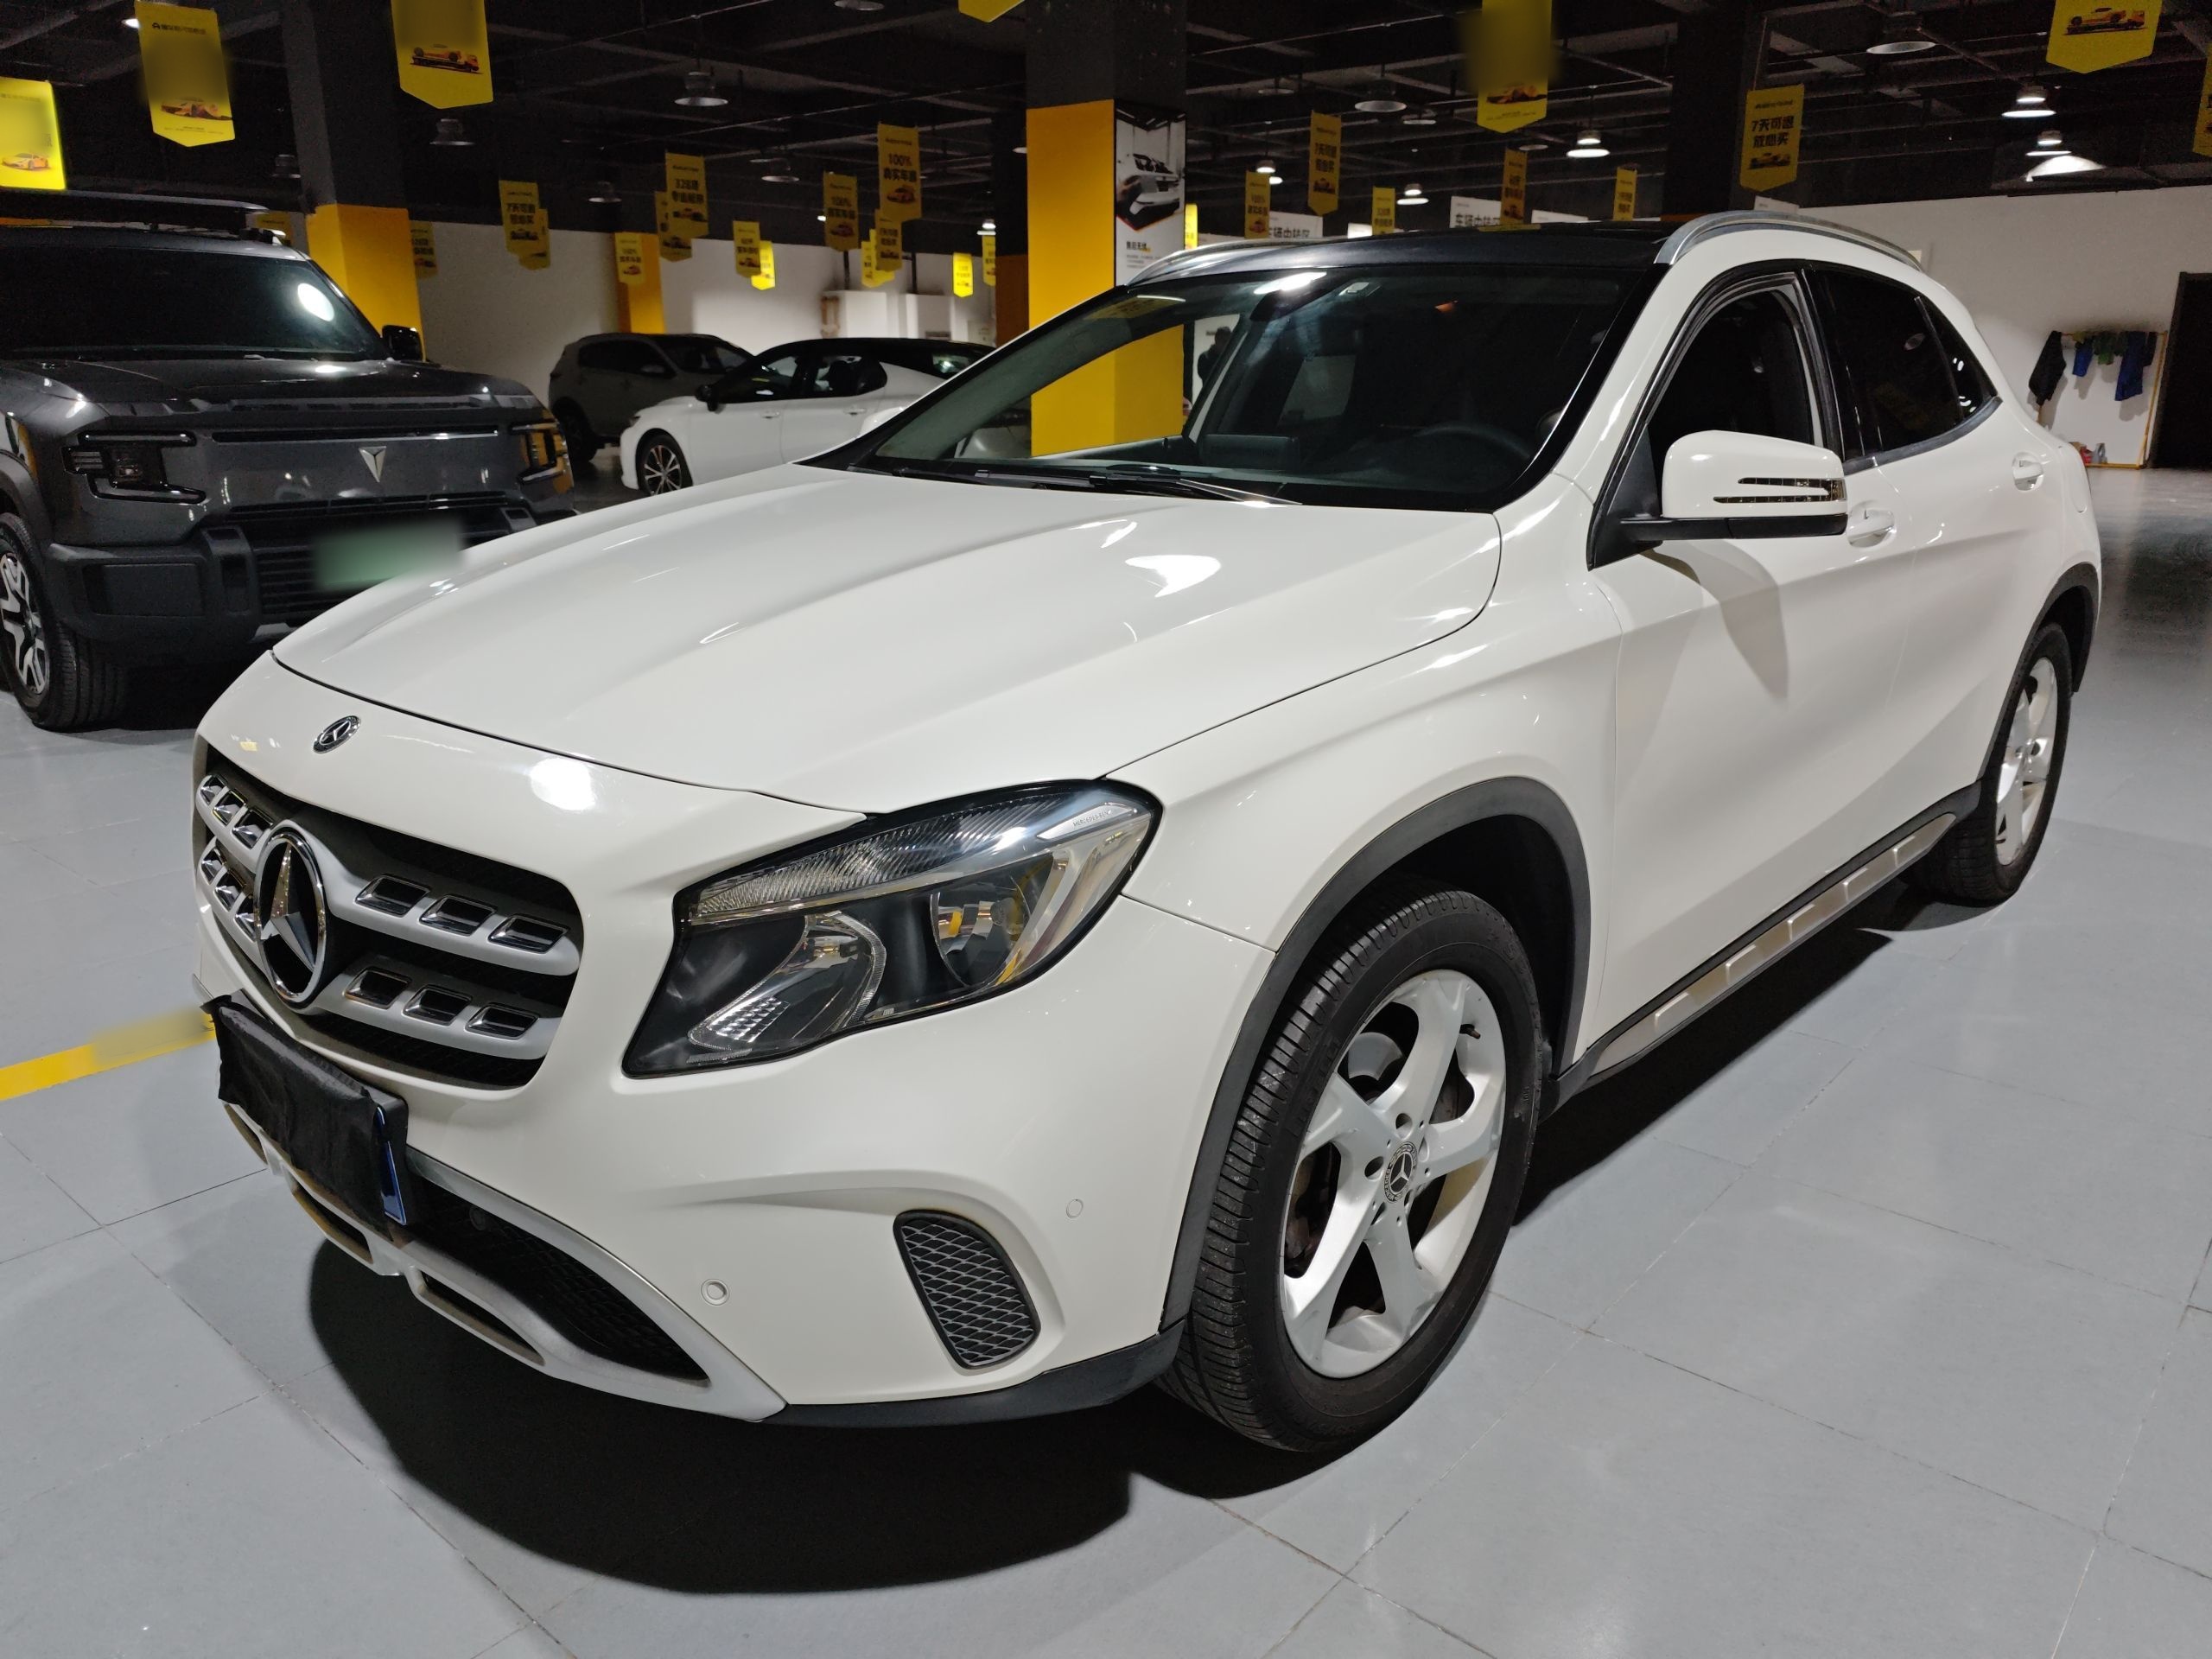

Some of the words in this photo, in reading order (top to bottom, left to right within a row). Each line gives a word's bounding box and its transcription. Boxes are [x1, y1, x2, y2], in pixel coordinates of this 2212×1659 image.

[1751, 116, 1794, 131] 7天可退
[1753, 132, 1789, 148] 放心买
